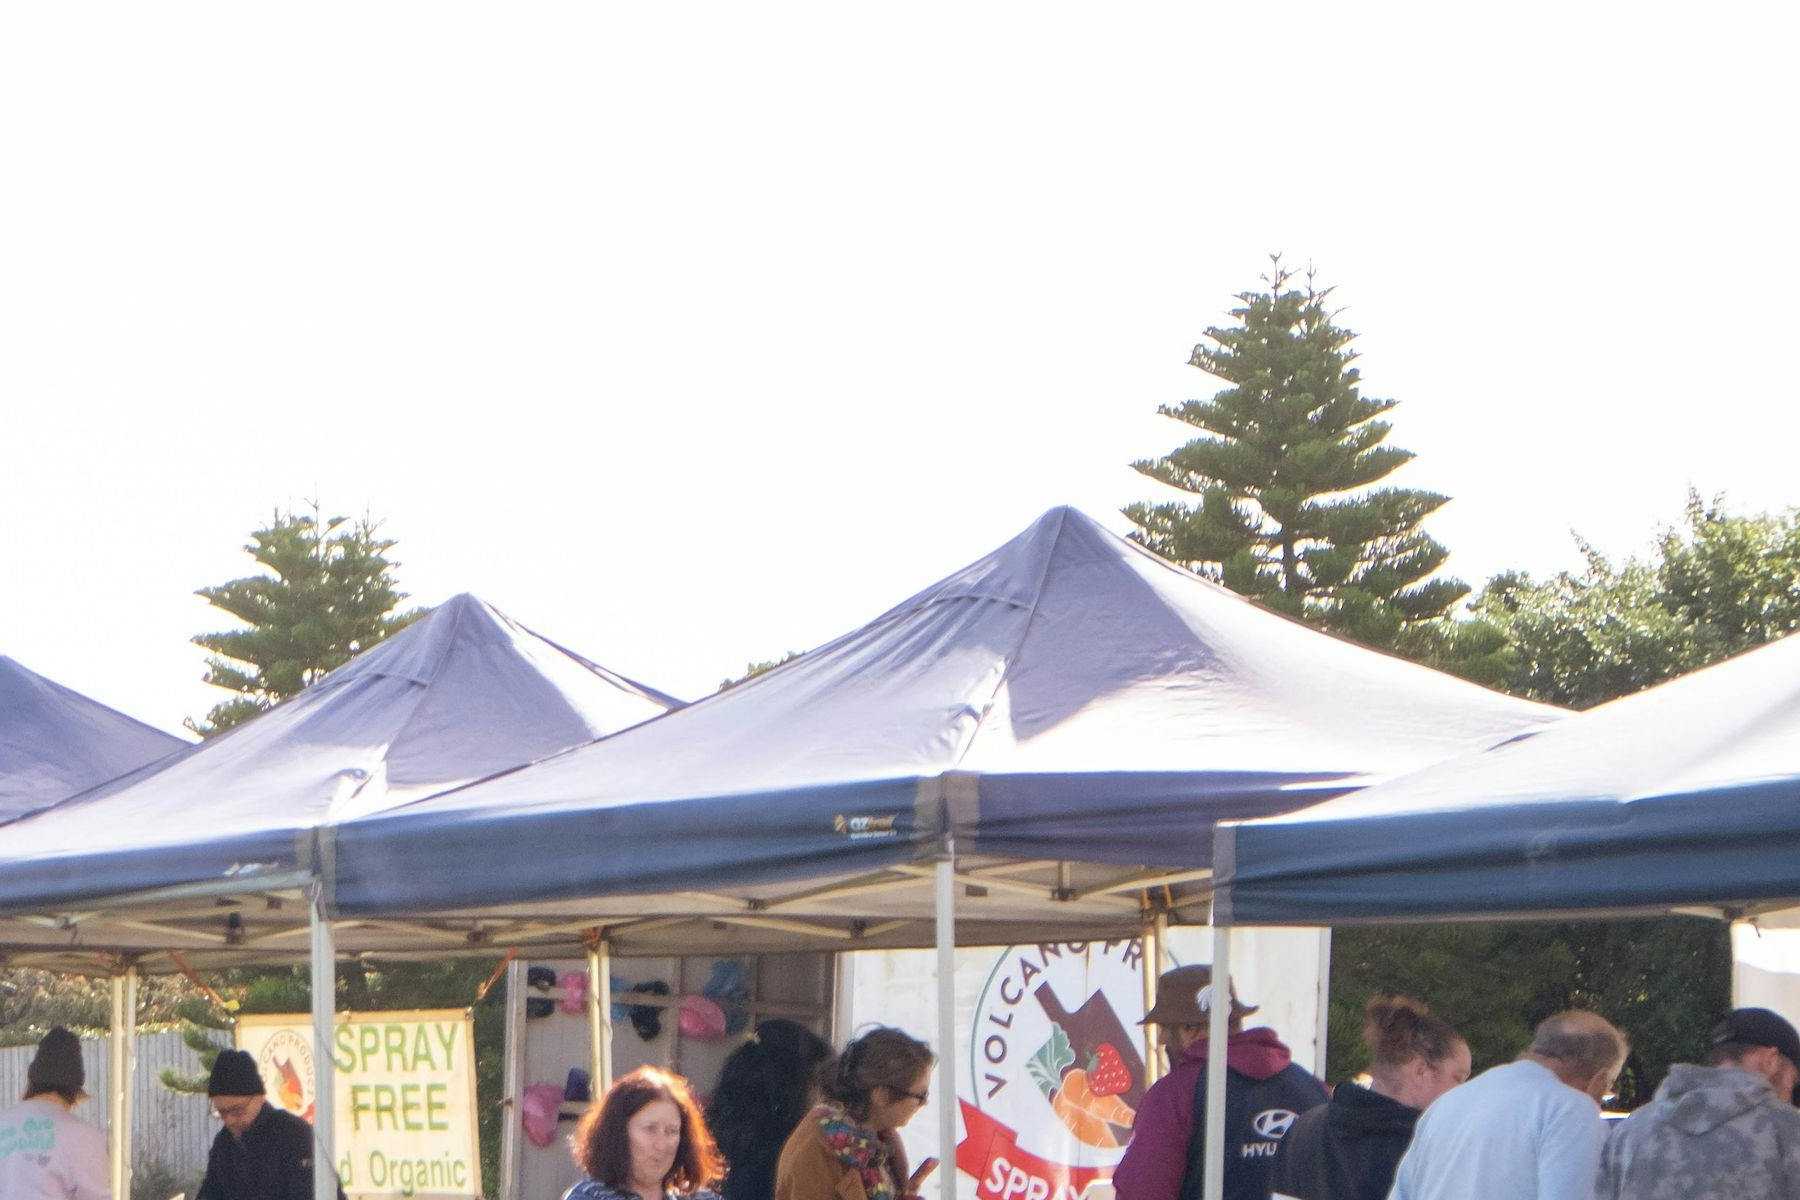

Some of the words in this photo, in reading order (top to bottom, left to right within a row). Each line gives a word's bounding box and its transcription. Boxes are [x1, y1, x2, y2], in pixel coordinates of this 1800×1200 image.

[333, 1023, 458, 1074] SPRAY
[352, 1083, 449, 1132] FREE
[369, 1150, 467, 1196] Organic
